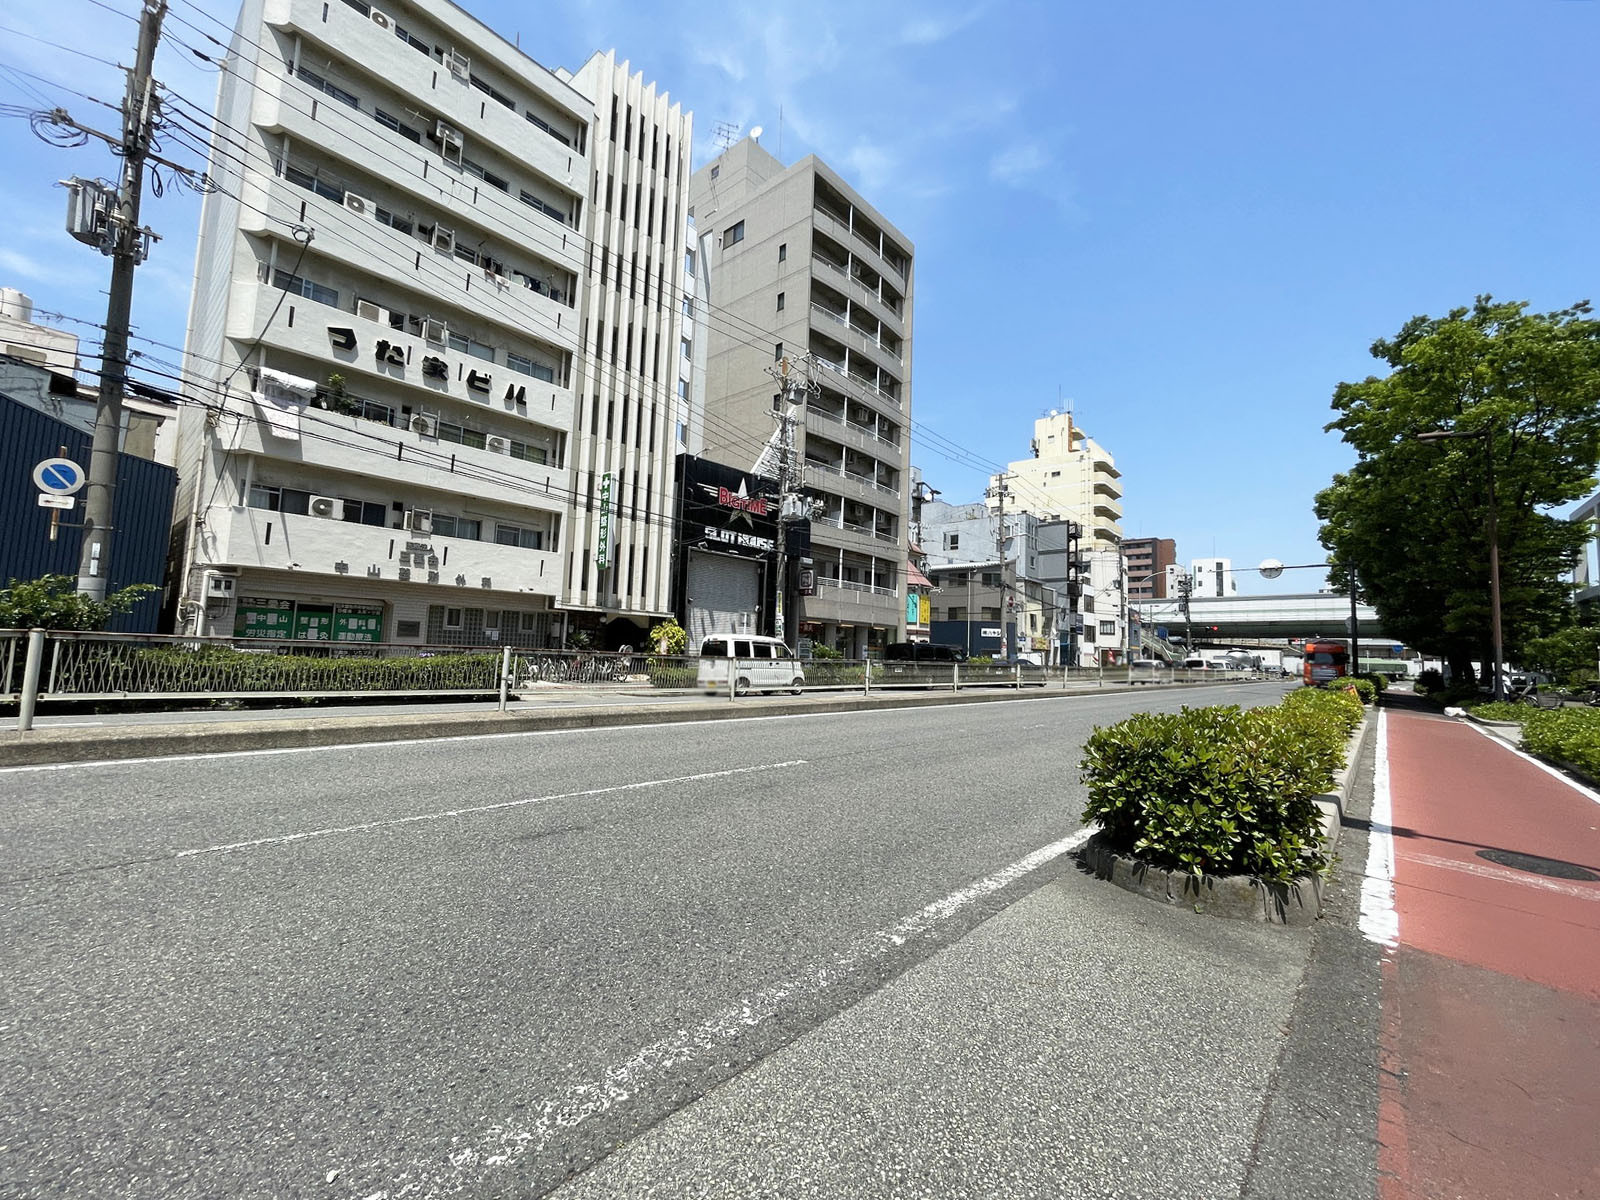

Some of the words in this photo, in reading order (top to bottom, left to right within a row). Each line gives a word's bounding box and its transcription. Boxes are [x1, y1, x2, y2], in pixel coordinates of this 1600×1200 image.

[705, 526, 736, 544] SLOT
[738, 533, 775, 551] HOUSE
[245, 628, 287, 639] 労災指定
